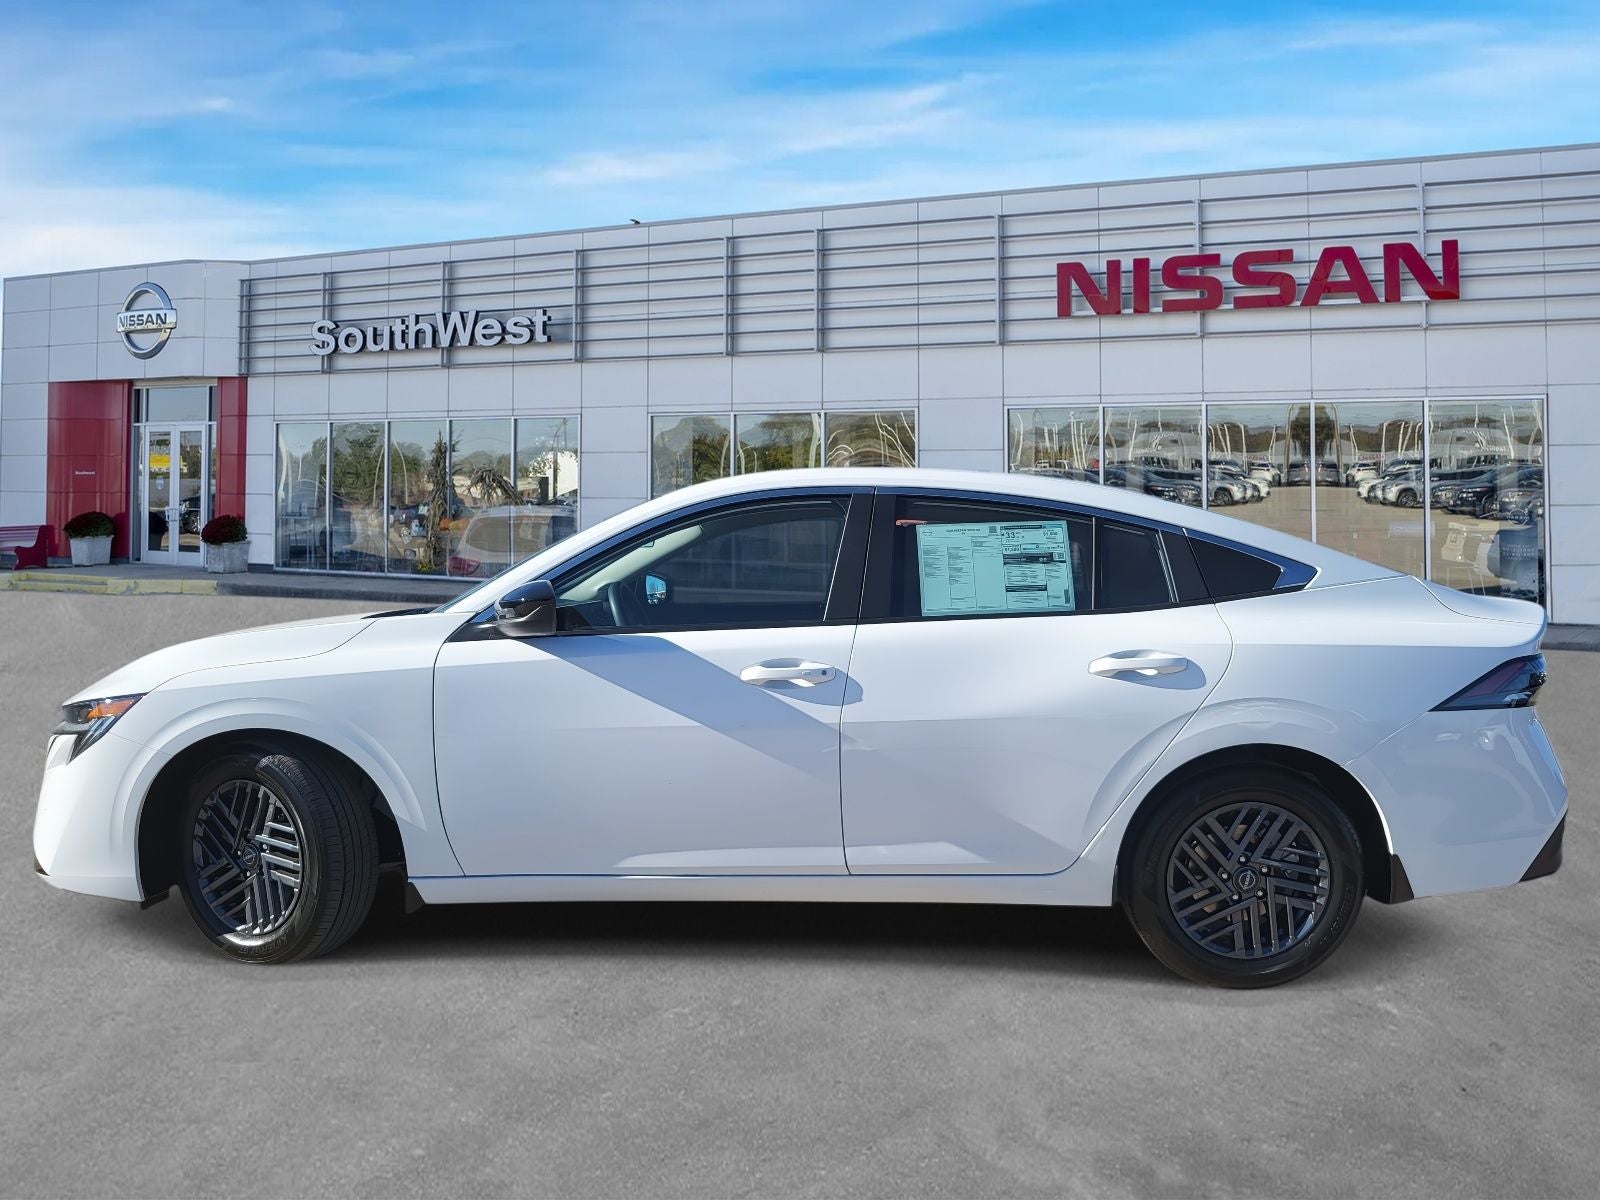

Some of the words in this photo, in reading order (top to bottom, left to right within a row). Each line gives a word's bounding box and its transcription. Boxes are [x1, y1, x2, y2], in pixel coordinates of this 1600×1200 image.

[1056, 239, 1461, 318] NISSAN
[119, 312, 167, 328] NISSAN
[309, 309, 551, 355] SouthWest
